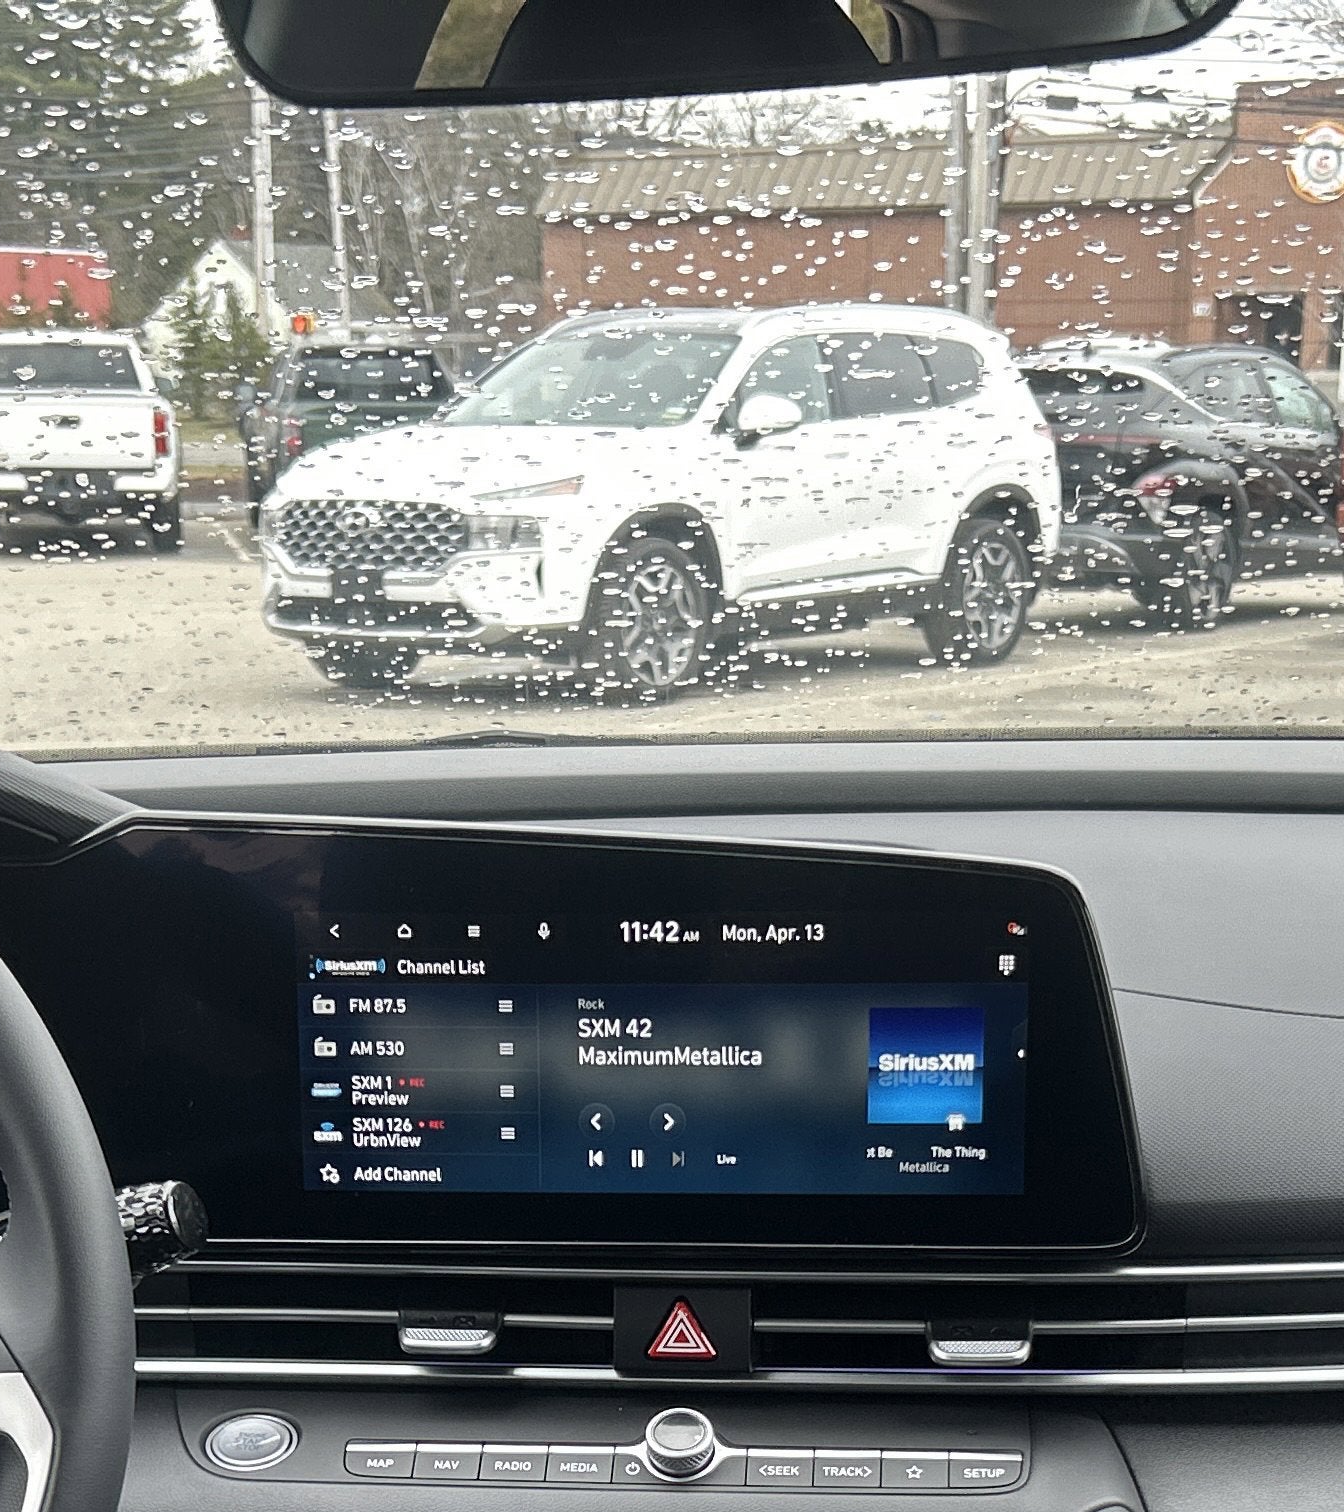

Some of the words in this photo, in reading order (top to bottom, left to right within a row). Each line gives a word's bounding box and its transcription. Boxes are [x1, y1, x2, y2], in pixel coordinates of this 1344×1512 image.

[620, 921, 679, 942] 11:42
[683, 931, 699, 942] AM
[722, 924, 762, 942] Mon,
[765, 925, 801, 944] Apr.
[805, 924, 824, 941] 13
[397, 960, 455, 975] Channel
[459, 960, 485, 975] List
[350, 998, 370, 1013] FM
[374, 998, 406, 1014] 87.5
[577, 998, 605, 1010] Rock
[578, 1018, 620, 1038] SXM
[626, 1018, 652, 1038] 42
[350, 1041, 372, 1056] AM
[376, 1041, 405, 1056] 530
[578, 1046, 763, 1066] MaximumMetallica
[878, 1053, 975, 1072] SiriusXM
[352, 1075, 383, 1090] SXM
[386, 1075, 392, 1090] 1
[352, 1091, 409, 1106] Preview
[353, 1118, 383, 1132] SXM
[386, 1118, 413, 1132] 126
[428, 1120, 446, 1129] REC
[353, 1133, 421, 1148] UrbnView
[716, 1154, 736, 1165] Live
[877, 1146, 893, 1158] Be
[930, 1146, 952, 1158] The
[954, 1146, 986, 1160] Thing
[354, 1167, 381, 1182] Add
[384, 1166, 442, 1182] Channel
[899, 1161, 950, 1173] Metallica
[366, 1458, 395, 1469] MAP
[434, 1459, 460, 1471] NAV
[494, 1460, 532, 1473] RADIO
[560, 1462, 598, 1474] MEDIA
[963, 1467, 1005, 1479] SETUP
